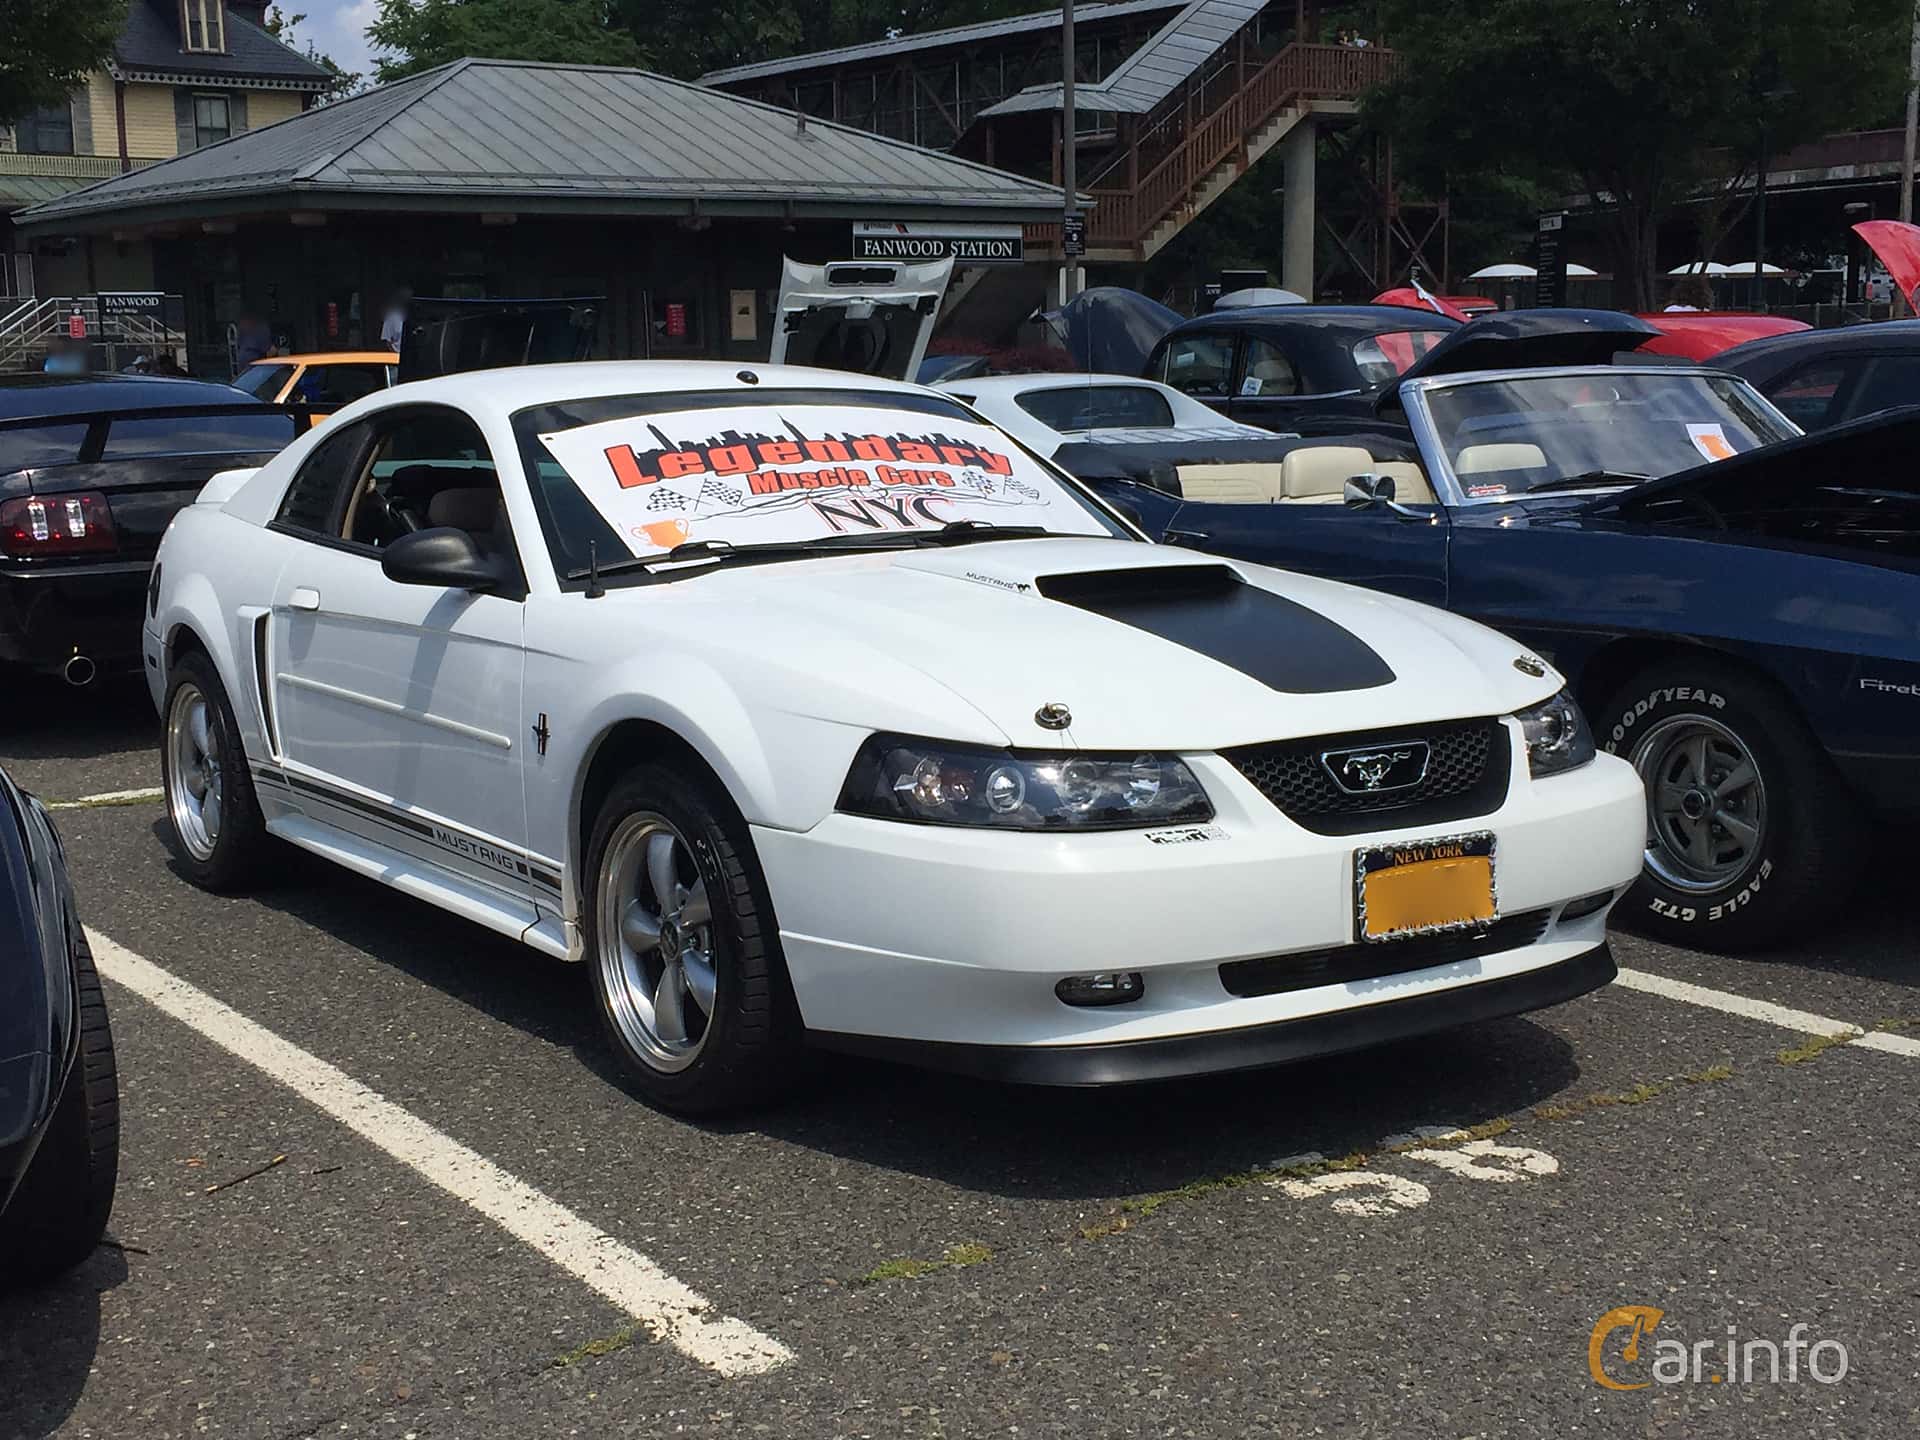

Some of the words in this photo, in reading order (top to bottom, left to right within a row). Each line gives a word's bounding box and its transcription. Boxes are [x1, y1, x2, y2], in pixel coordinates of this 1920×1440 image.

[863, 239, 944, 256] FANWOOD
[949, 239, 1014, 257] STATION
[105, 297, 160, 307] FANWOOD
[604, 435, 1015, 490] Legendary
[746, 467, 872, 495] Muscle
[875, 464, 956, 488] Cars
[806, 495, 964, 532] NYC
[965, 571, 1014, 590] MUSTANG
[1604, 686, 1727, 755] GOODYEAR
[435, 829, 515, 871] MUSTANG
[1394, 848, 1426, 866] NEW
[1431, 843, 1465, 860] YORK
[1708, 857, 1773, 921] EAGLE
